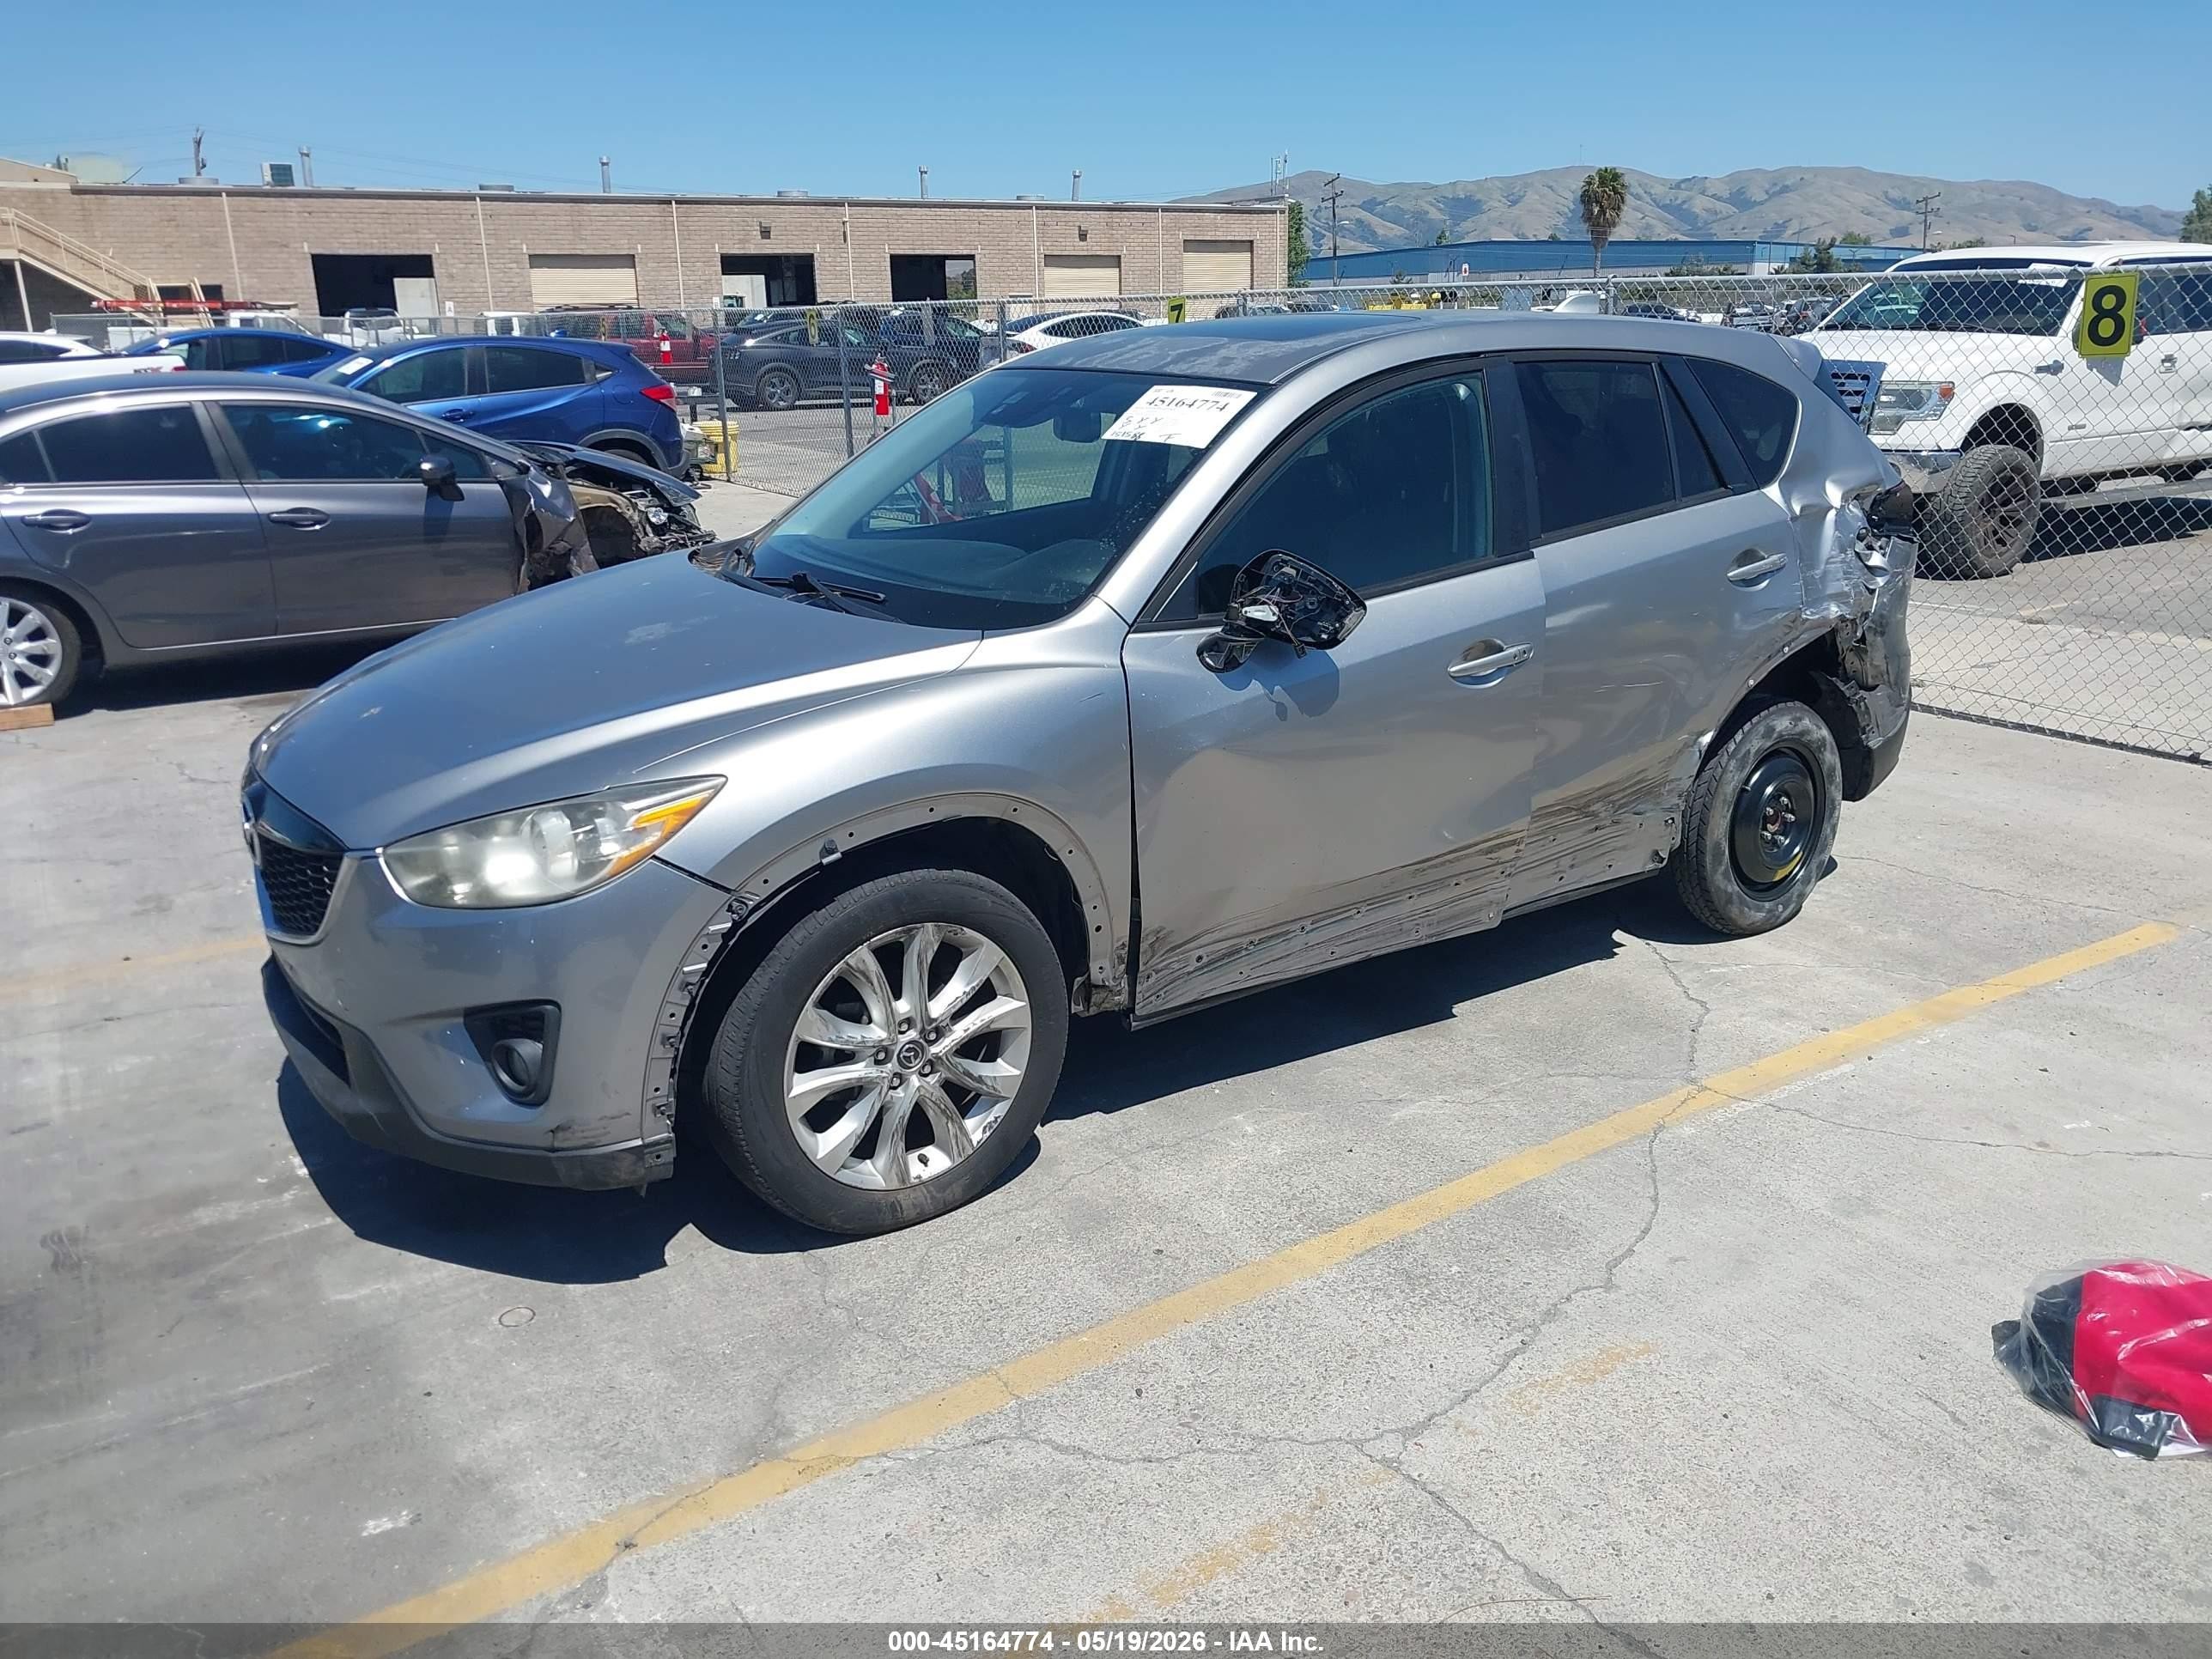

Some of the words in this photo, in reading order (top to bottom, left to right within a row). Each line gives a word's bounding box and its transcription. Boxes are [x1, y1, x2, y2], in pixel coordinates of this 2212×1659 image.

[1170, 303, 1183, 324] 7
[2087, 285, 2127, 347] 8
[808, 313, 817, 339] 6
[1146, 397, 1230, 411] 45164774
